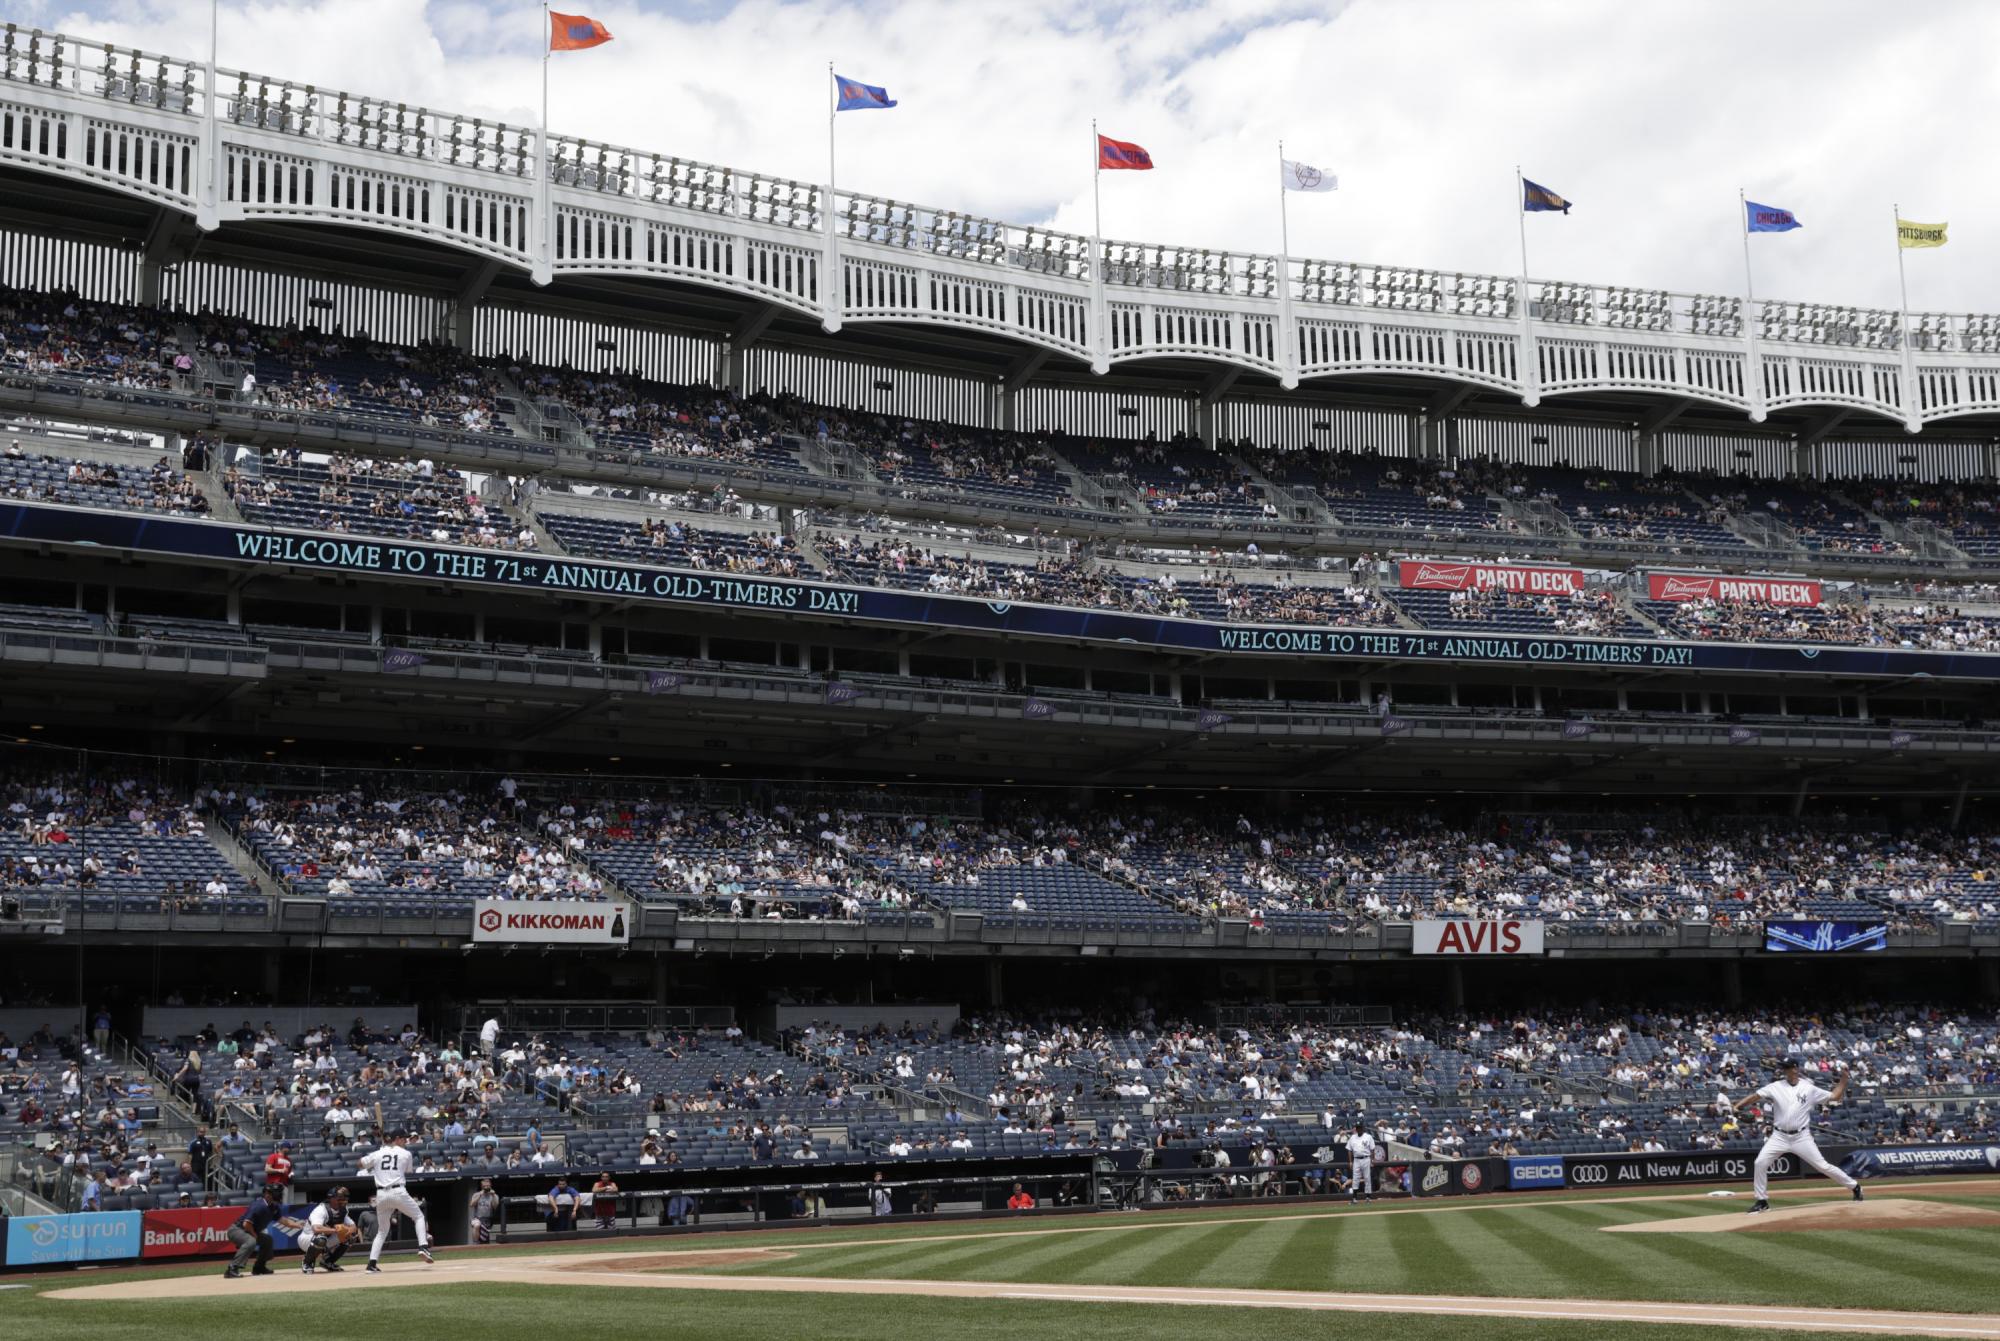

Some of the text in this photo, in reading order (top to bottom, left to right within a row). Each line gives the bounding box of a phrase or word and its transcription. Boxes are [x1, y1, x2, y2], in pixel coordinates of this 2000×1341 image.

[235, 532, 859, 613] WELCOME TO THE 71st ANNUAL OLD-TIMERS' DAY!
[1418, 568, 1573, 592] Budweiser PARTY DECK
[1666, 581, 1813, 604] Budweiser PARTY DECK
[1219, 629, 1693, 665] WELCOME TO THE 71st ANNUAL OLD-TIMERS' DAY!
[1027, 703, 1048, 714] 1978
[507, 913, 605, 930] KIKKOMAN
[1436, 921, 1522, 953] AVIS
[381, 1154, 398, 1171] 21
[1876, 1149, 1982, 1164] WEATHERPROOF
[1513, 1164, 1563, 1180] GEICO
[1618, 1159, 1746, 1180] All New Audi Q5
[144, 1229, 187, 1246] Bank
[187, 1227, 203, 1242] of
[31, 1249, 60, 1263] Save
[103, 1245, 126, 1257] Sun
